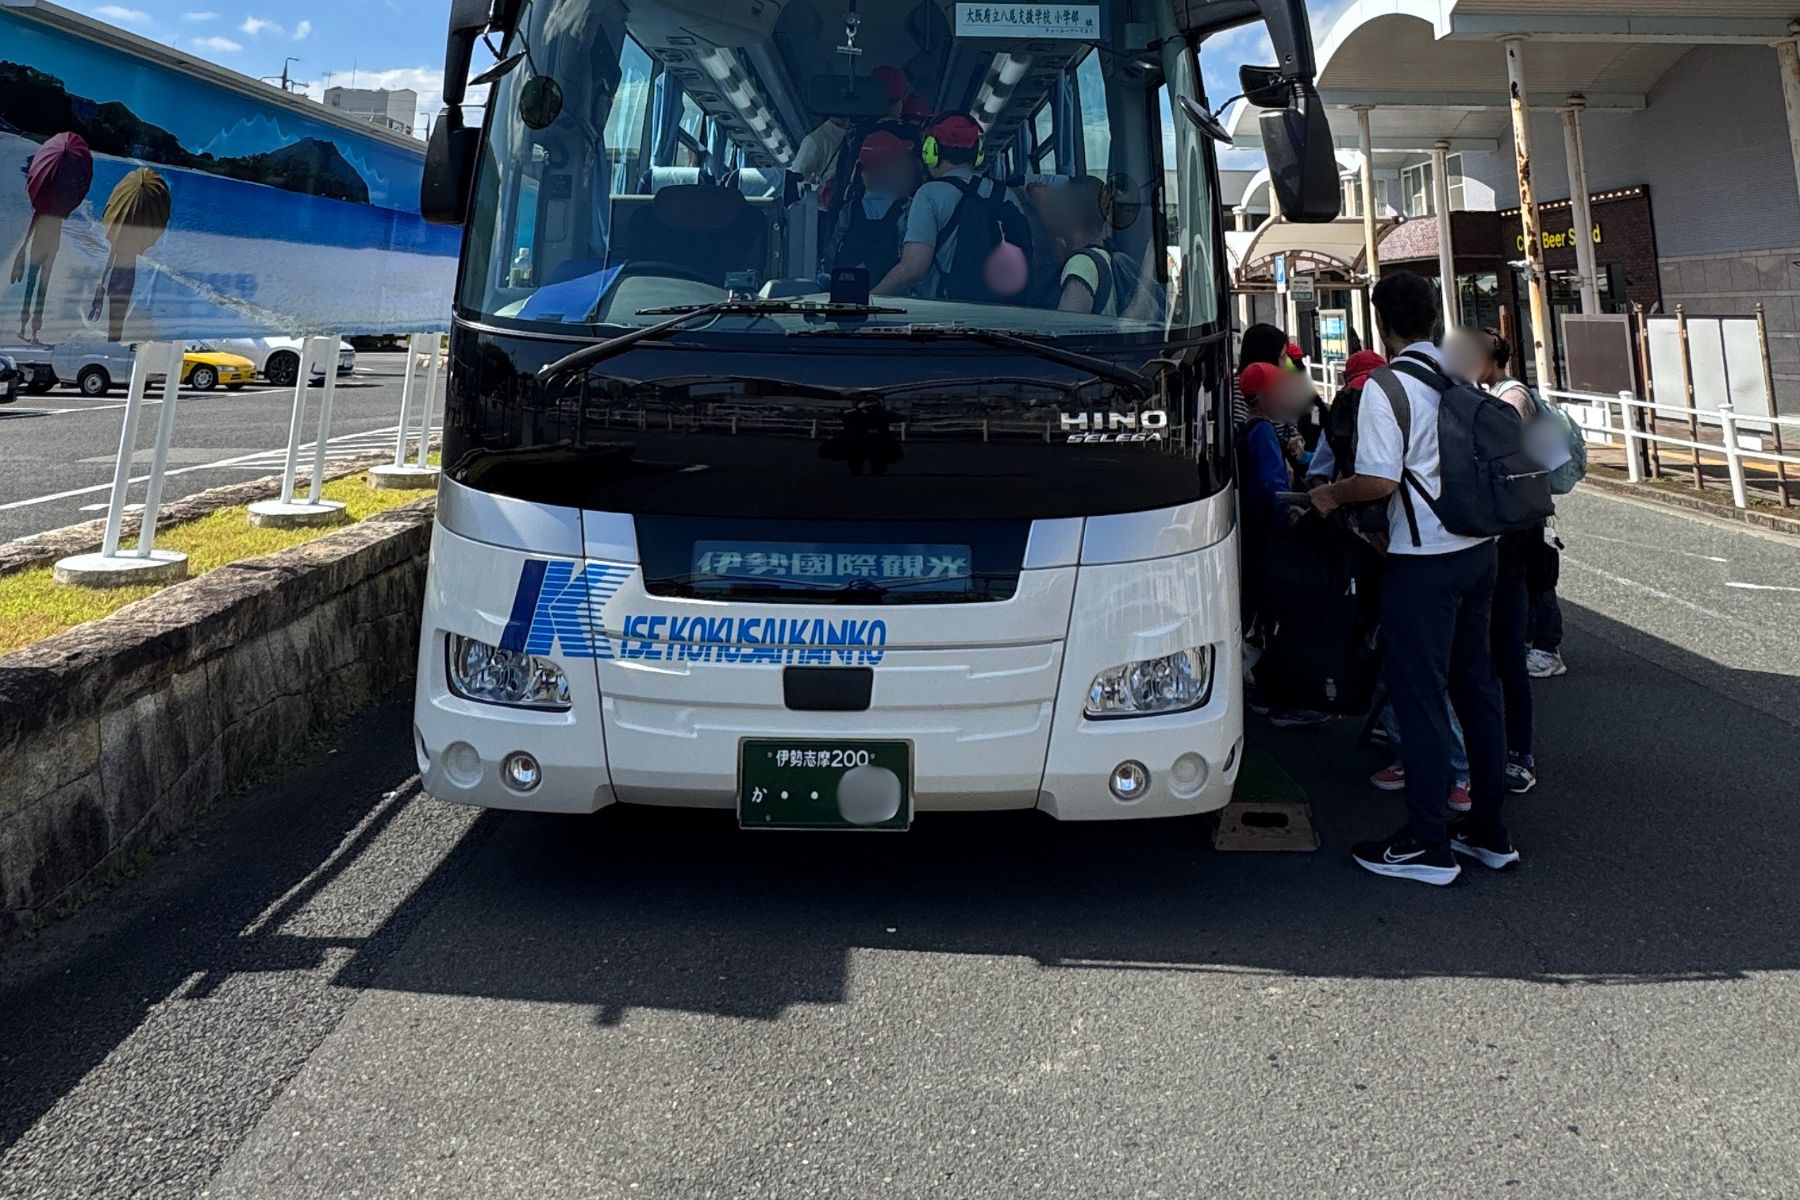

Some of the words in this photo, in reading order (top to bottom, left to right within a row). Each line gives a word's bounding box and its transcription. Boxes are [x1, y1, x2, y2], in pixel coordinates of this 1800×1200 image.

[1541, 231, 1566, 249] Beer
[1060, 410, 1168, 430] HINO
[620, 615, 668, 660] ISE
[751, 786, 768, 803] か
